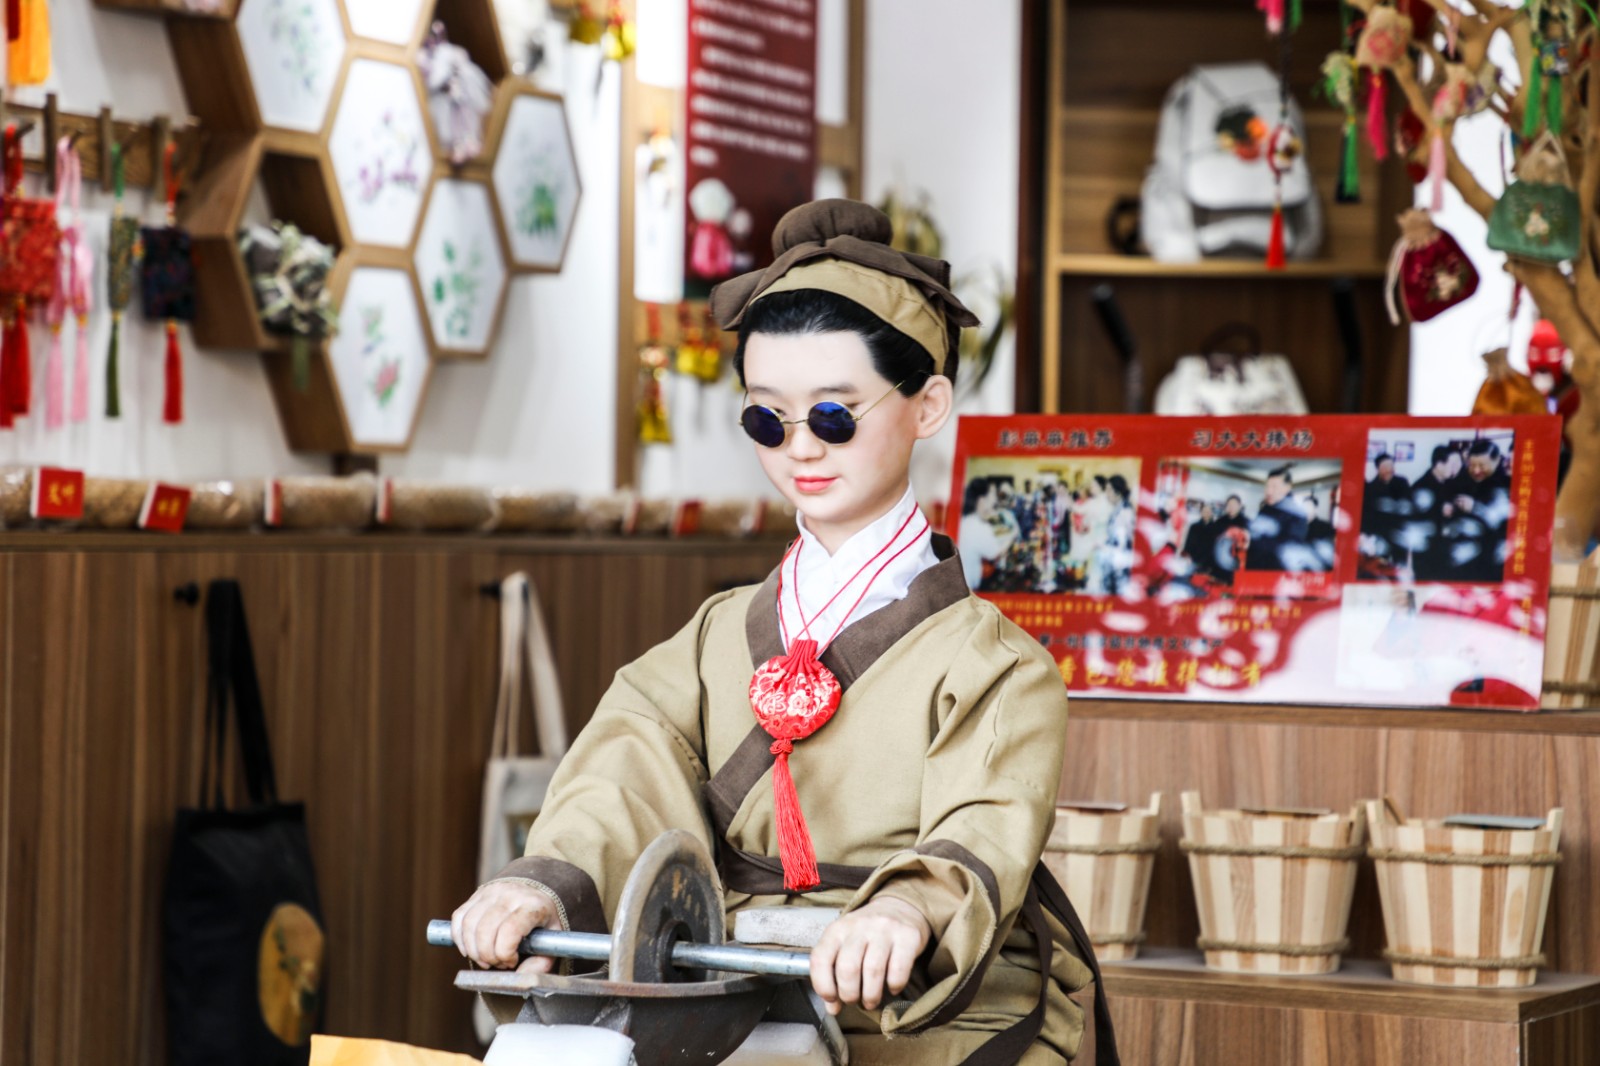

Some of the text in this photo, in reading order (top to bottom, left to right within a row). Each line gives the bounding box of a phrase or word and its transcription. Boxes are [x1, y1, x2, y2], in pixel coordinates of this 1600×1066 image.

[997, 429, 1113, 448] 彭麻麻推荐
[1190, 429, 1314, 450] 习大大捧场
